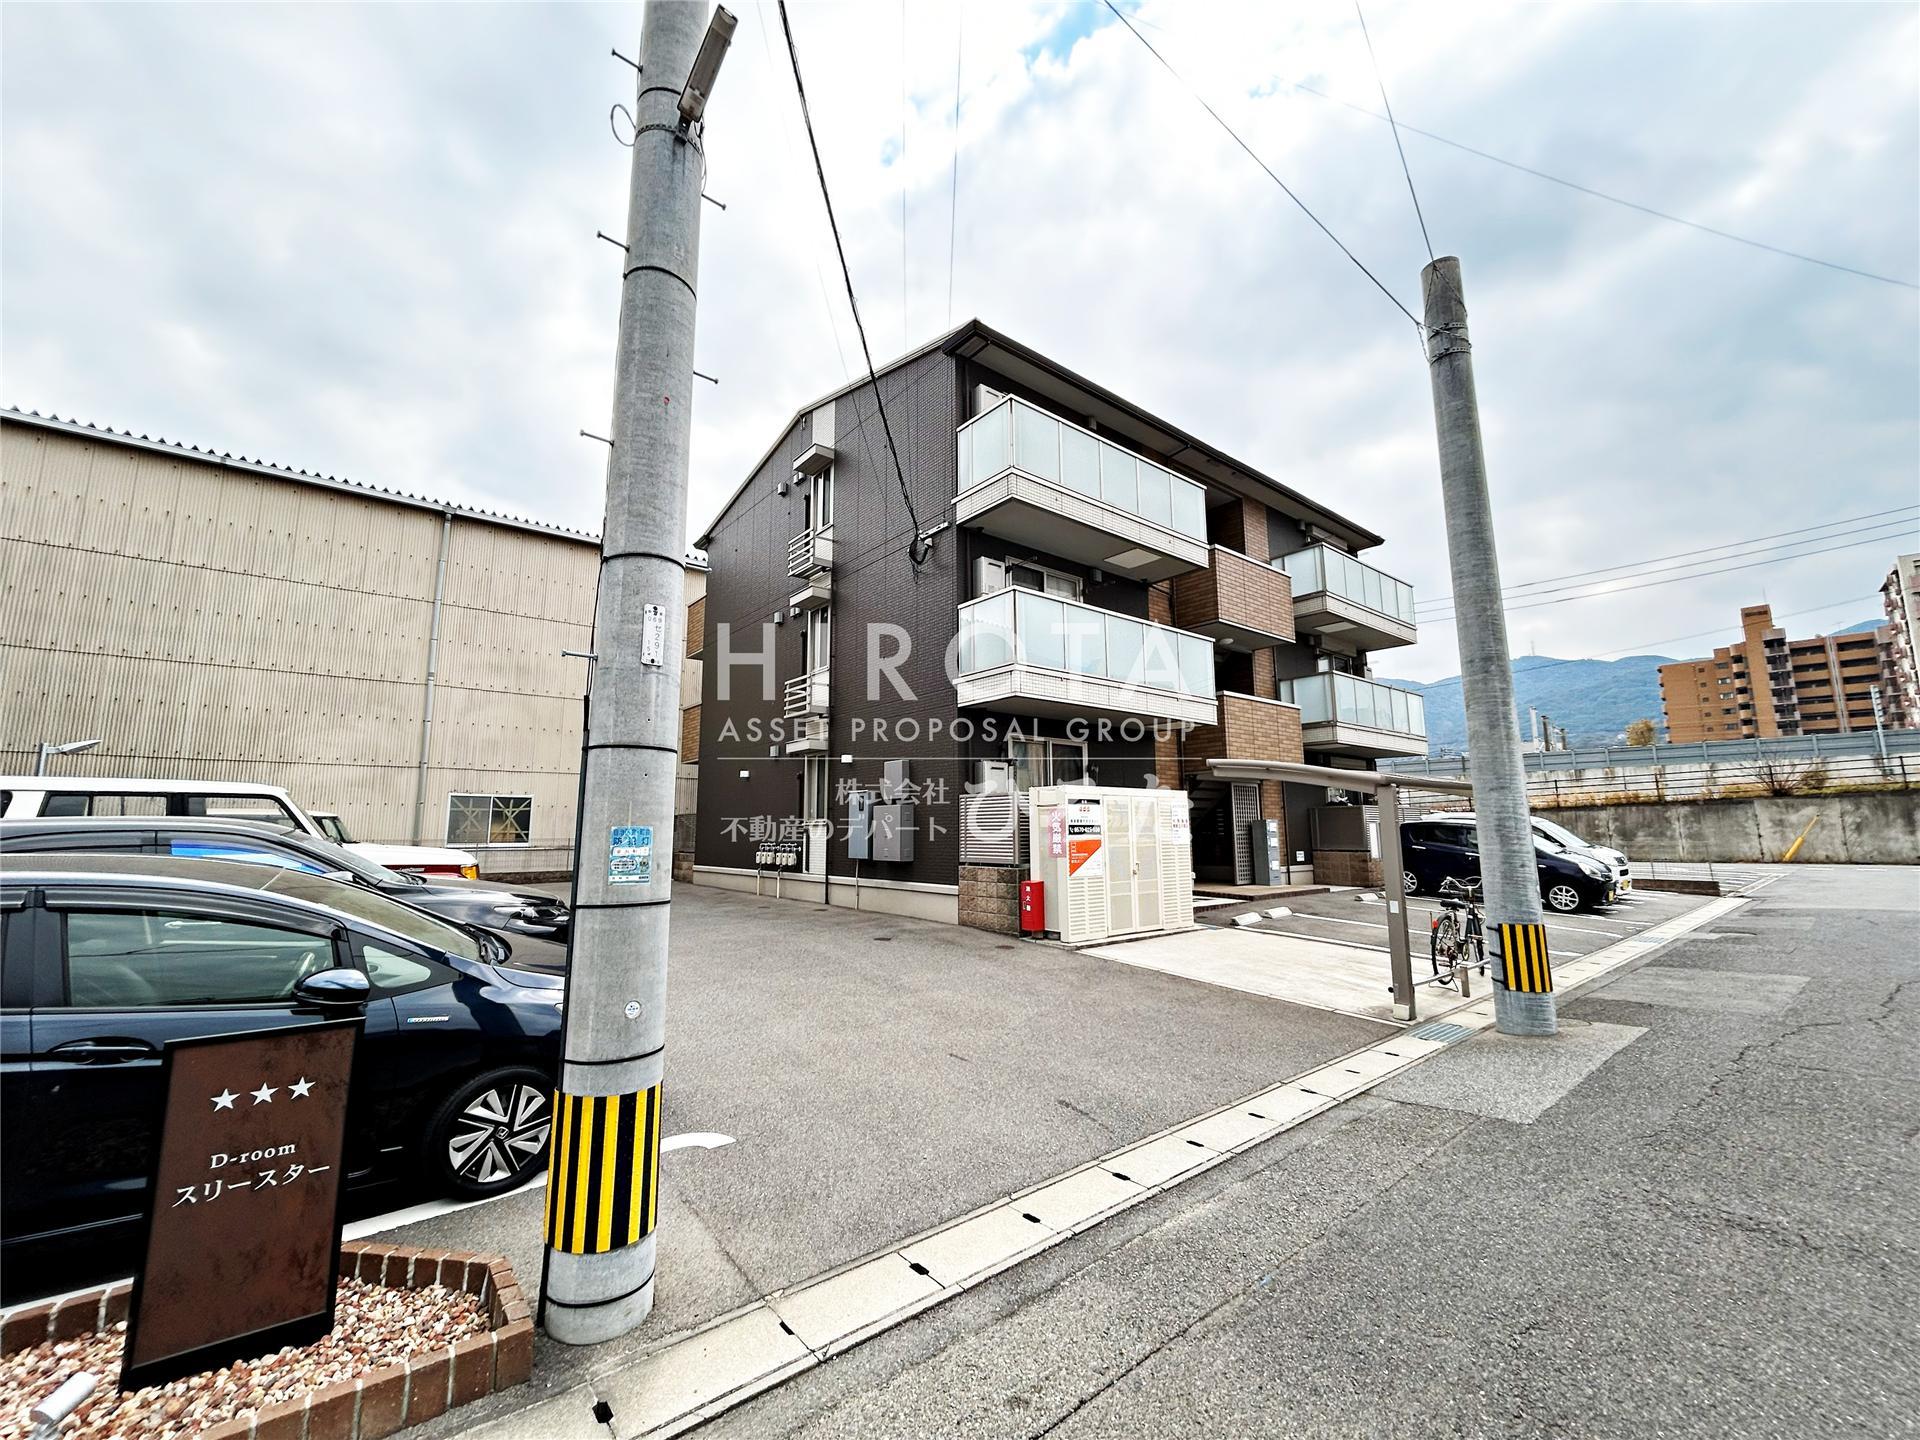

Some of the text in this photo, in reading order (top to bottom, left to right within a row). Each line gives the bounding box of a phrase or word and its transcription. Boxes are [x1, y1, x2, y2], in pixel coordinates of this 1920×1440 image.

[210, 1143, 296, 1168] D-room
[172, 1164, 330, 1208] スリースター
